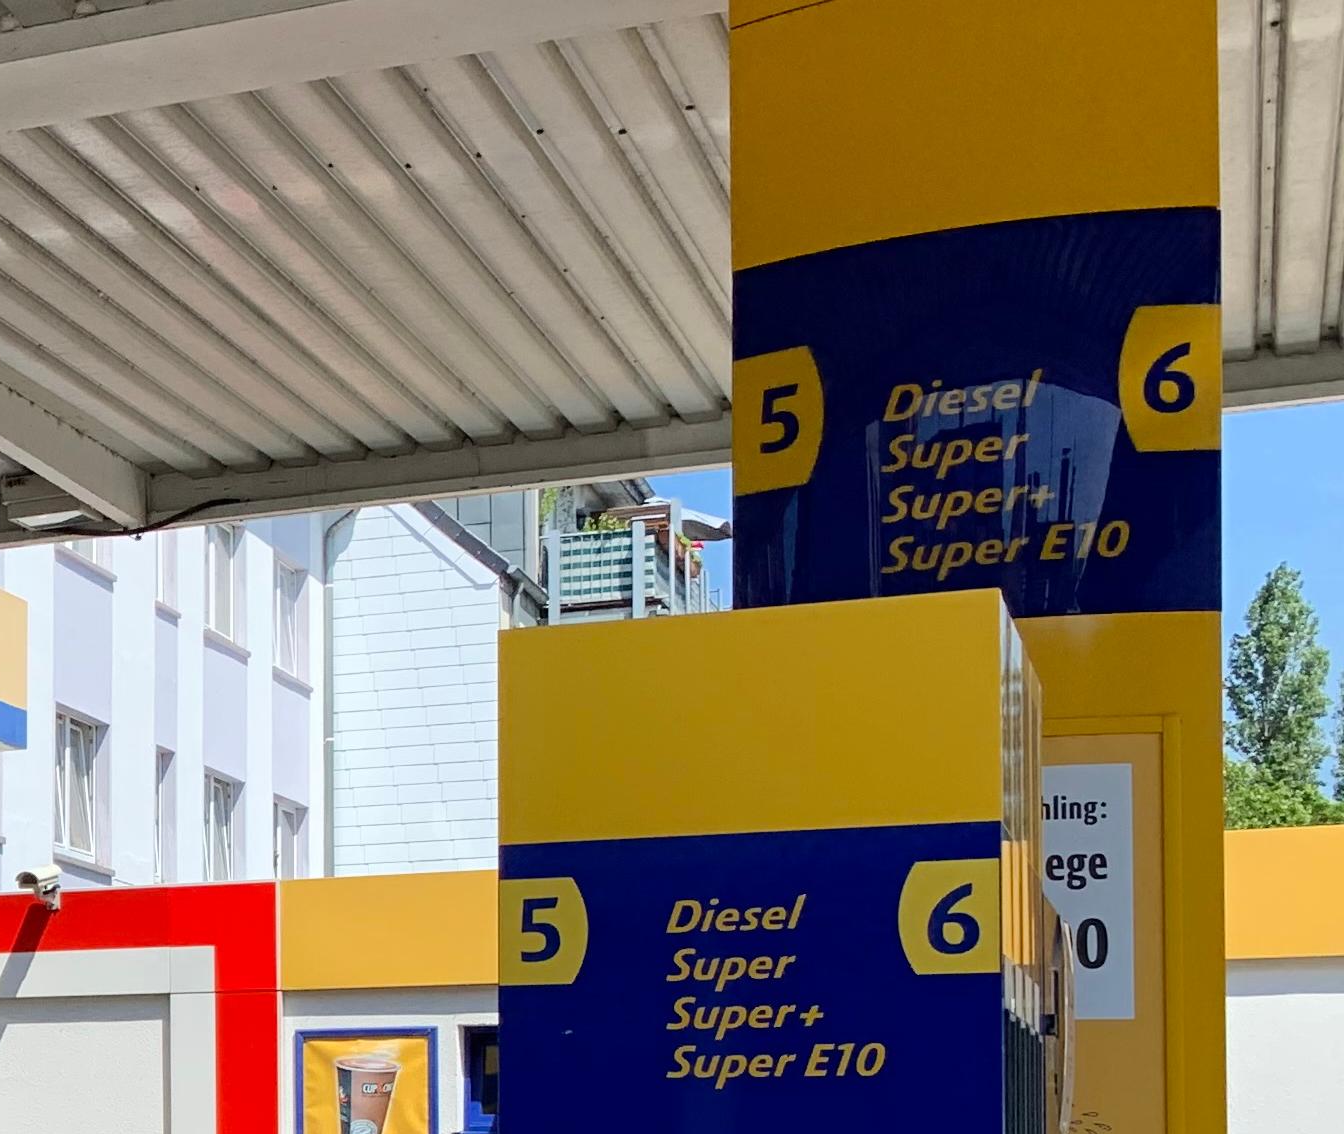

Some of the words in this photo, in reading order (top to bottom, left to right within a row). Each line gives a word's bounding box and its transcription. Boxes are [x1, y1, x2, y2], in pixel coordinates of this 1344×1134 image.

[882, 368, 1045, 422] Diesel
[1143, 342, 1196, 414] 6
[759, 383, 800, 454] 5
[880, 433, 1029, 480] Super
[880, 484, 1055, 530] Super+
[880, 535, 1030, 581] Super
[1040, 519, 1130, 560] E10
[520, 896, 561, 963] 5
[665, 894, 807, 934] Diesel
[927, 883, 980, 955] 6
[665, 948, 797, 992] Super
[665, 996, 825, 1040] Super+
[665, 1045, 797, 1089] Super
[803, 1042, 887, 1078] E10
